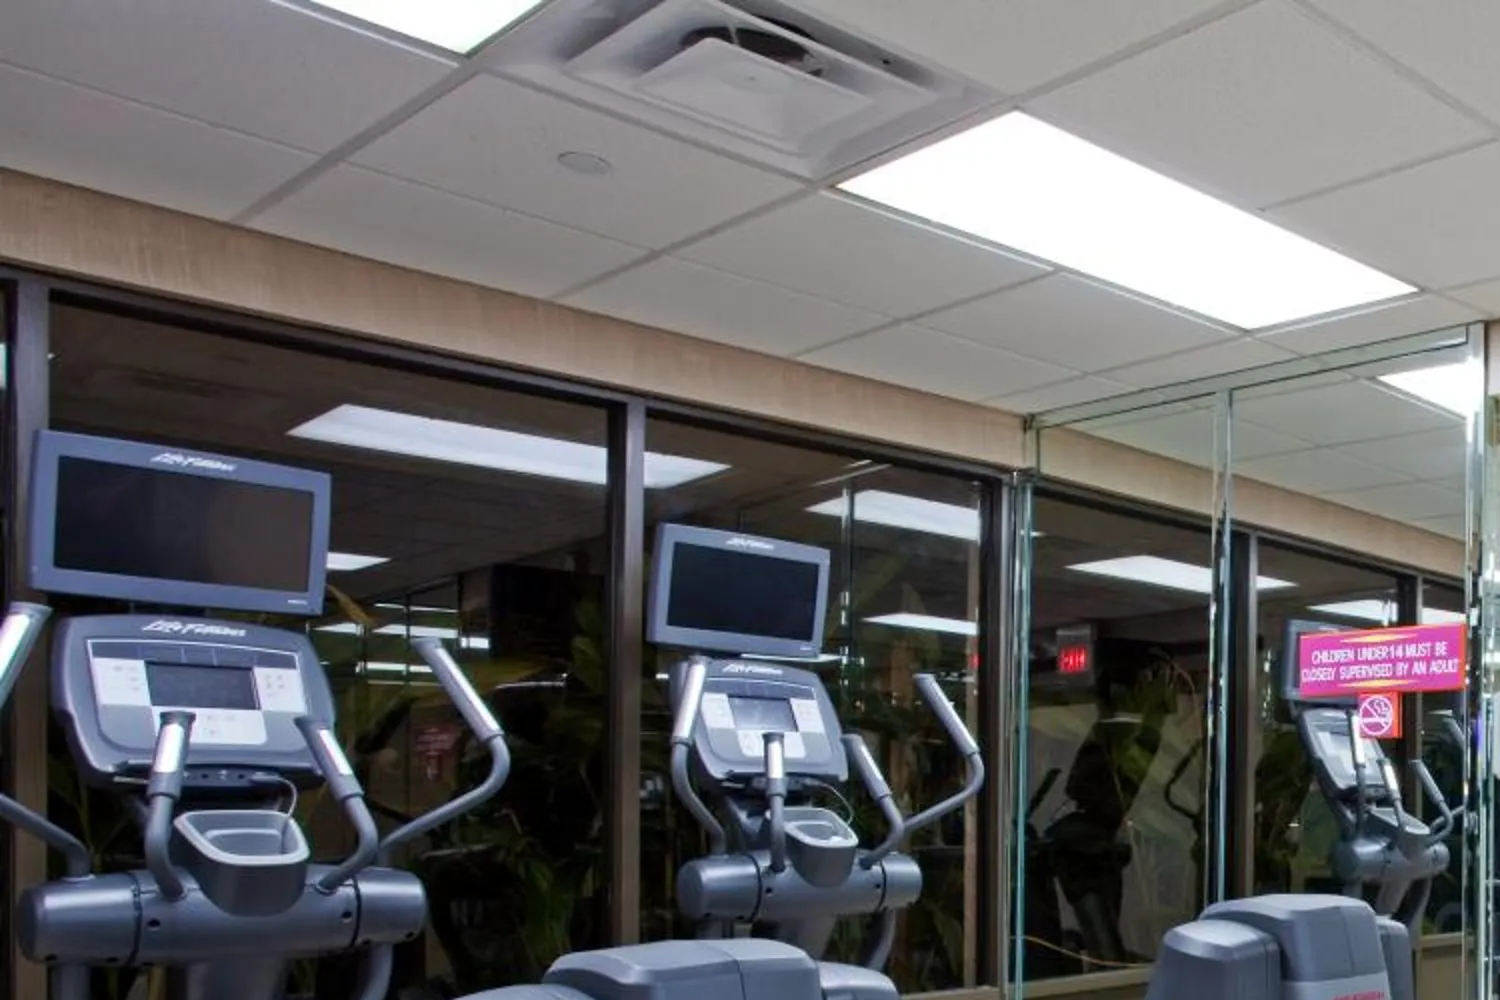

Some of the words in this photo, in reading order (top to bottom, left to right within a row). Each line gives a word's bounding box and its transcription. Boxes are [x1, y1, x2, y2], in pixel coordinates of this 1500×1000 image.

[1311, 648, 1354, 665] CHILDREN
[1357, 645, 1389, 661] UNDER
[1405, 642, 1432, 658] MUST
[1435, 640, 1449, 656] BE
[1301, 667, 1336, 682] CLOSELY
[1339, 662, 1393, 681] SUPERVISED
[1395, 661, 1409, 677] BY
[1412, 660, 1427, 676] AN
[1429, 658, 1459, 675] ADULT
